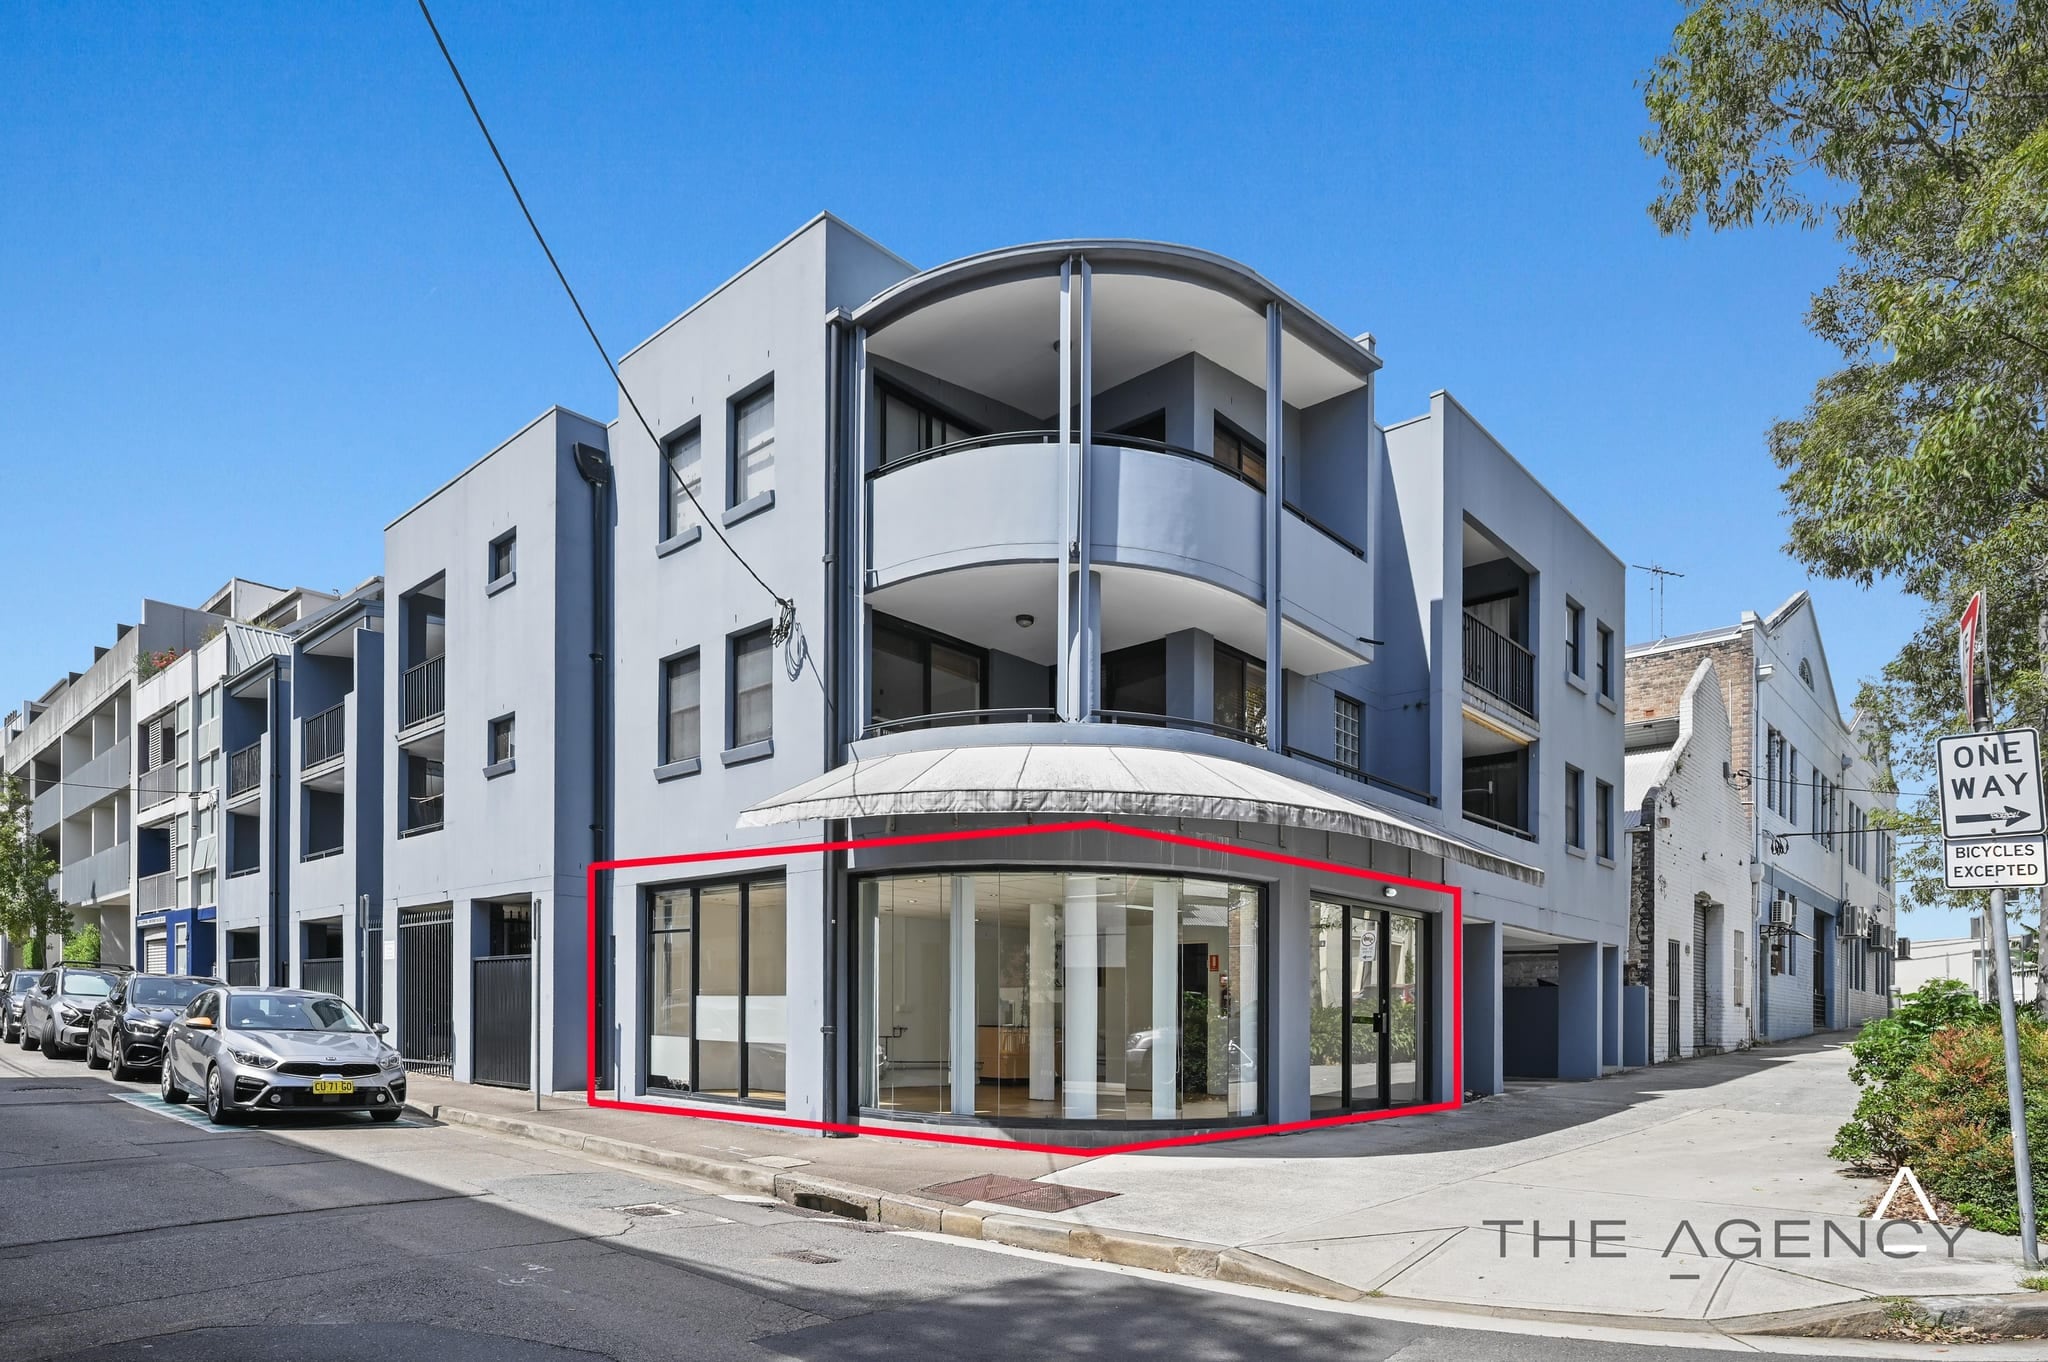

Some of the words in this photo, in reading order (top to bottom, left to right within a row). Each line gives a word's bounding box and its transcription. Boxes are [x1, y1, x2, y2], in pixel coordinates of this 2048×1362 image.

[1954, 741, 2022, 769] ONE
[1952, 772, 2028, 801] WAY
[1955, 844, 2035, 859] BICYCLES
[1954, 863, 2038, 878] EXCEPTED
[315, 1081, 326, 1091] CU
[328, 1082, 338, 1091] 71
